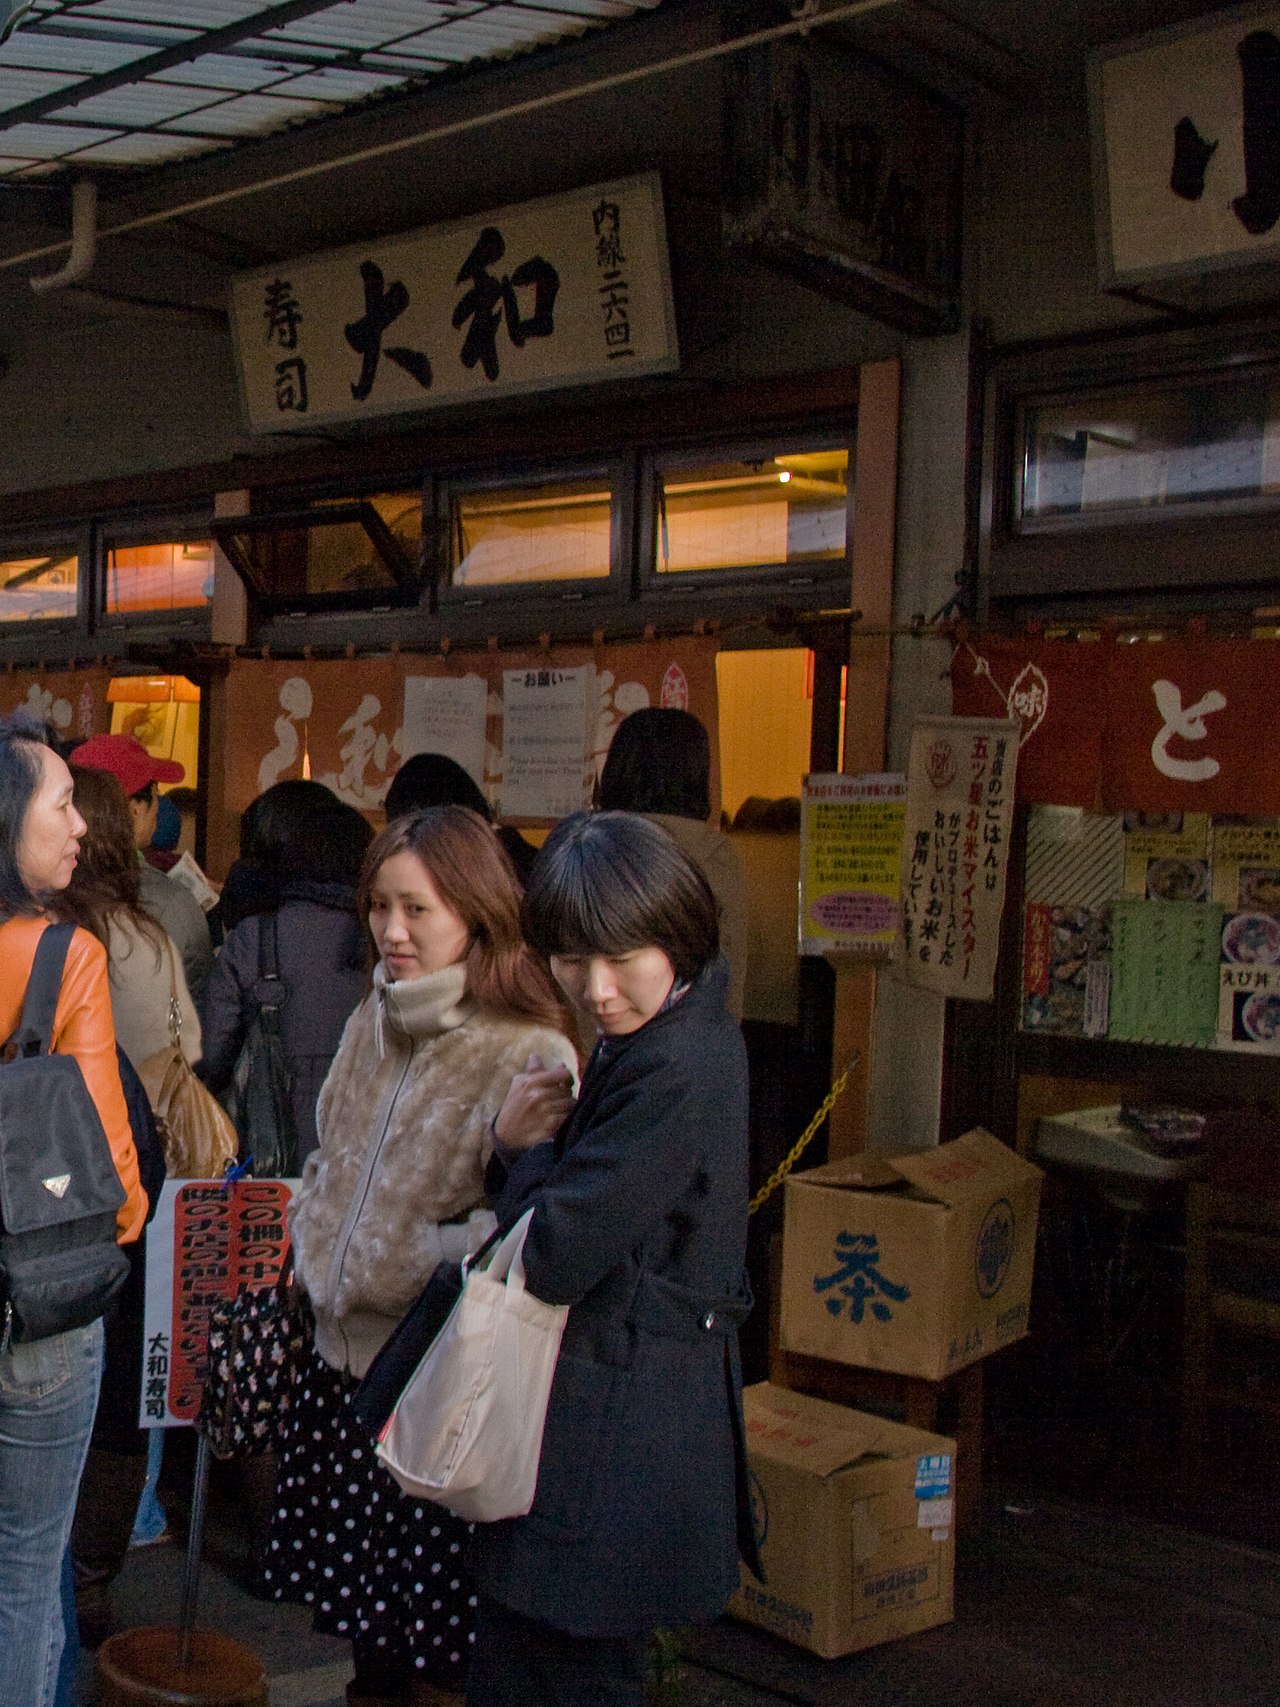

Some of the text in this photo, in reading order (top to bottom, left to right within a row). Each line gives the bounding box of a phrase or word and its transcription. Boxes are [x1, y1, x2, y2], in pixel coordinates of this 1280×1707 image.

[264, 278, 309, 414] 寿司
[345, 226, 561, 402] 大和
[1151, 678, 1228, 783] と
[813, 1230, 911, 1325] 茶
[144, 1332, 169, 1420] 大和寿司
